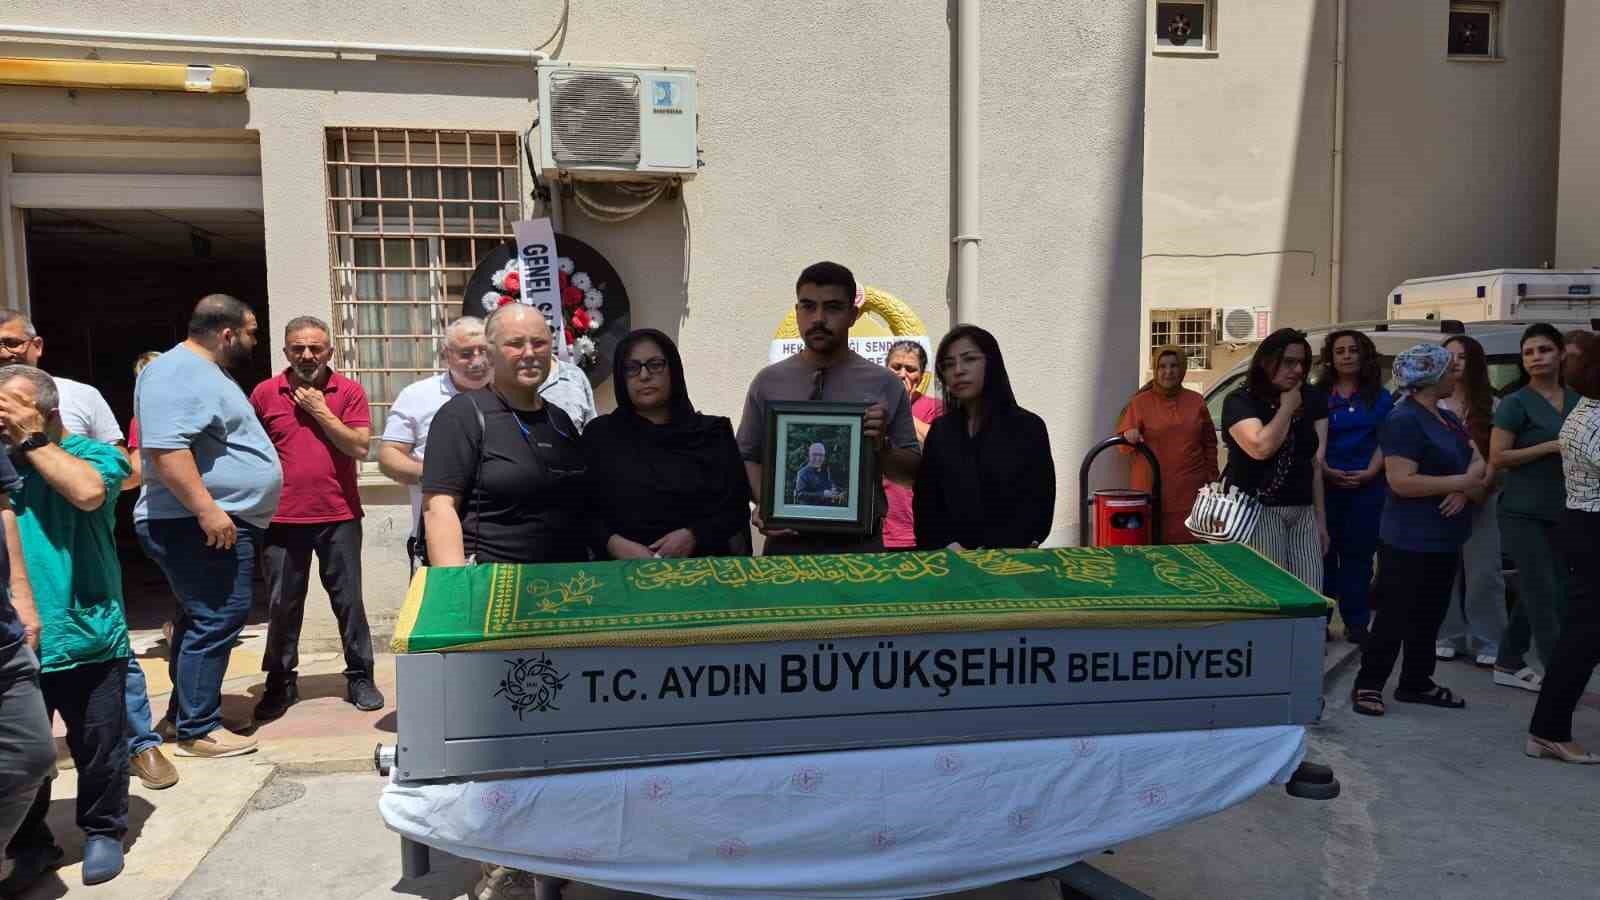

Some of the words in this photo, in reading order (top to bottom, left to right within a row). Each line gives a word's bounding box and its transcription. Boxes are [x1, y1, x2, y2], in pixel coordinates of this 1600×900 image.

[523, 244, 551, 299] GENEL
[783, 343, 803, 354] HEK
[582, 668, 647, 703] T.C.
[658, 663, 766, 699] AYDIN
[780, 637, 1056, 697] BÜYÜKŞEHİR
[1068, 640, 1253, 682] BELEDİYESİ
